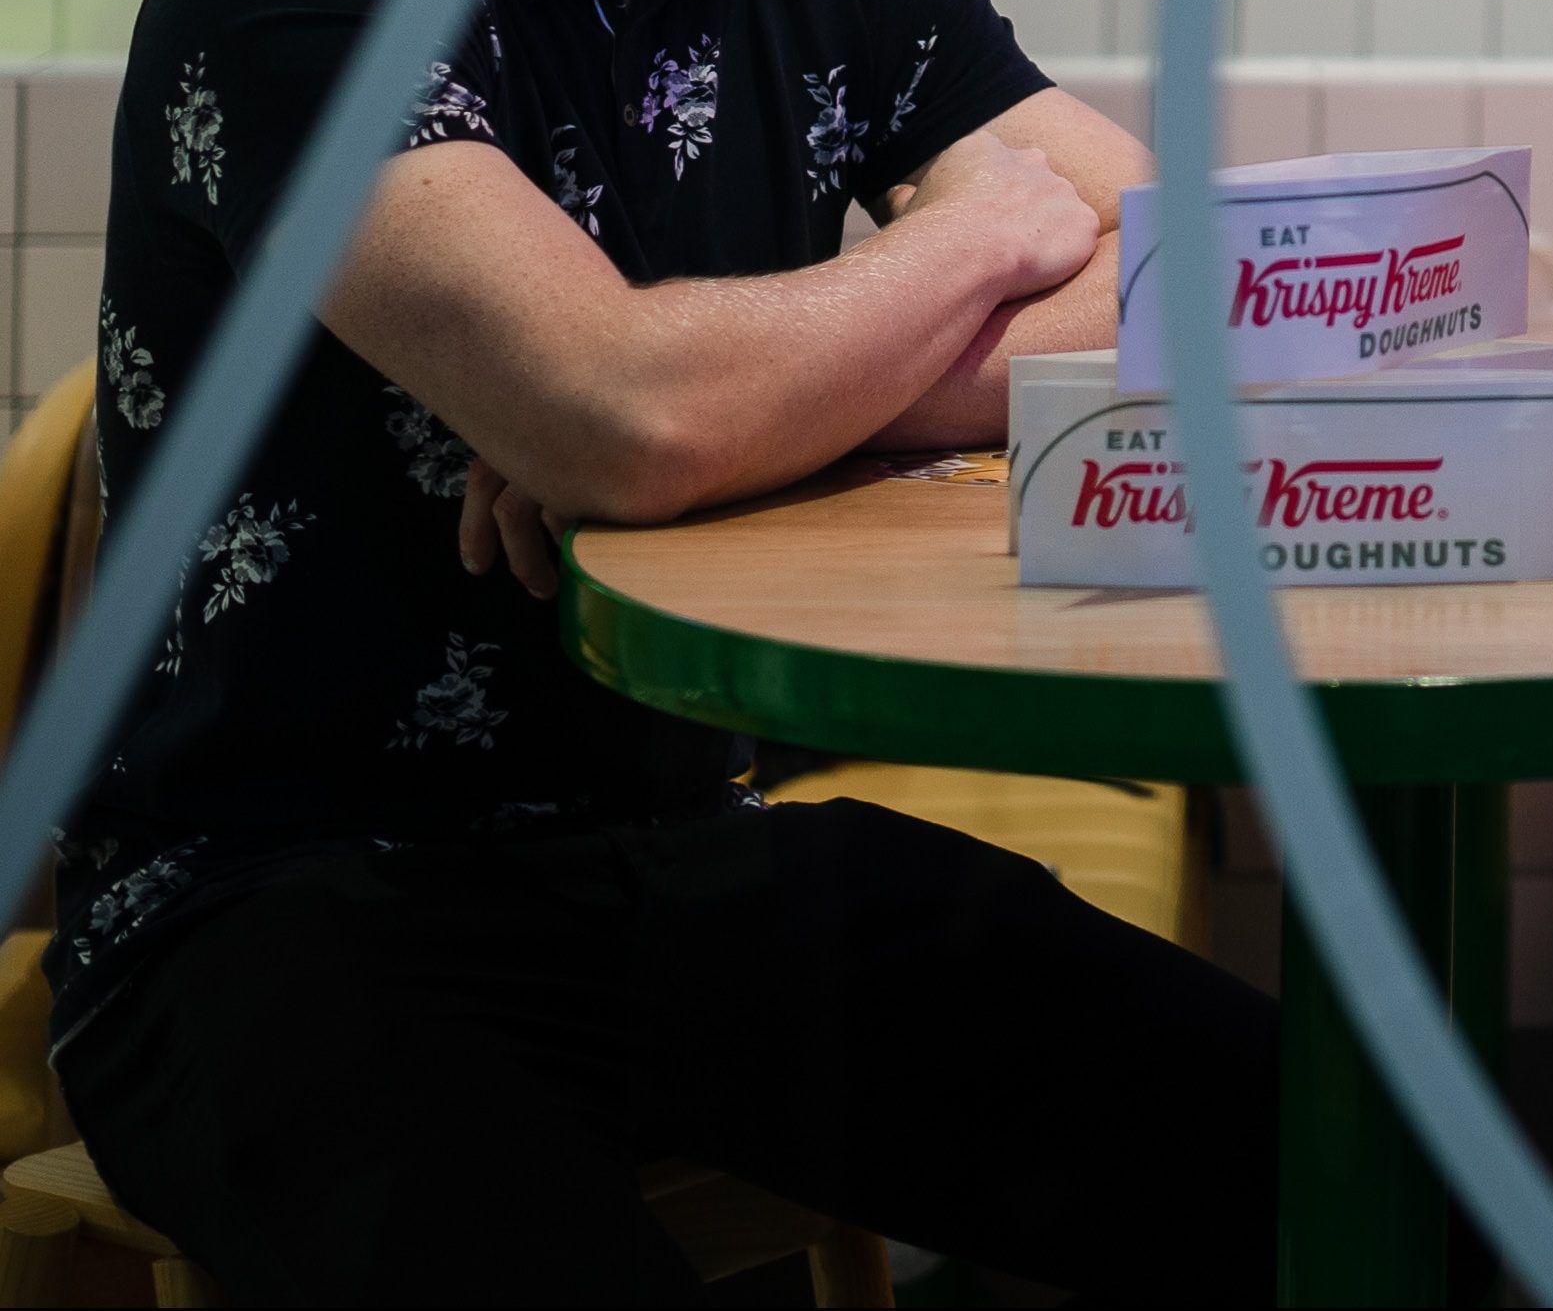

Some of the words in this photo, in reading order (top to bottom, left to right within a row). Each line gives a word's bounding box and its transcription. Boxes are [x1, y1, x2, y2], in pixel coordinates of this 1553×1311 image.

[1260, 225, 1310, 246] EAT
[1228, 250, 1383, 329] Krispy
[1359, 303, 1482, 359] DOUGHNUTS
[1106, 429, 1167, 451] EAT
[1071, 459, 1260, 534] Kris
[1261, 539, 1507, 571] OUGHNUTS
